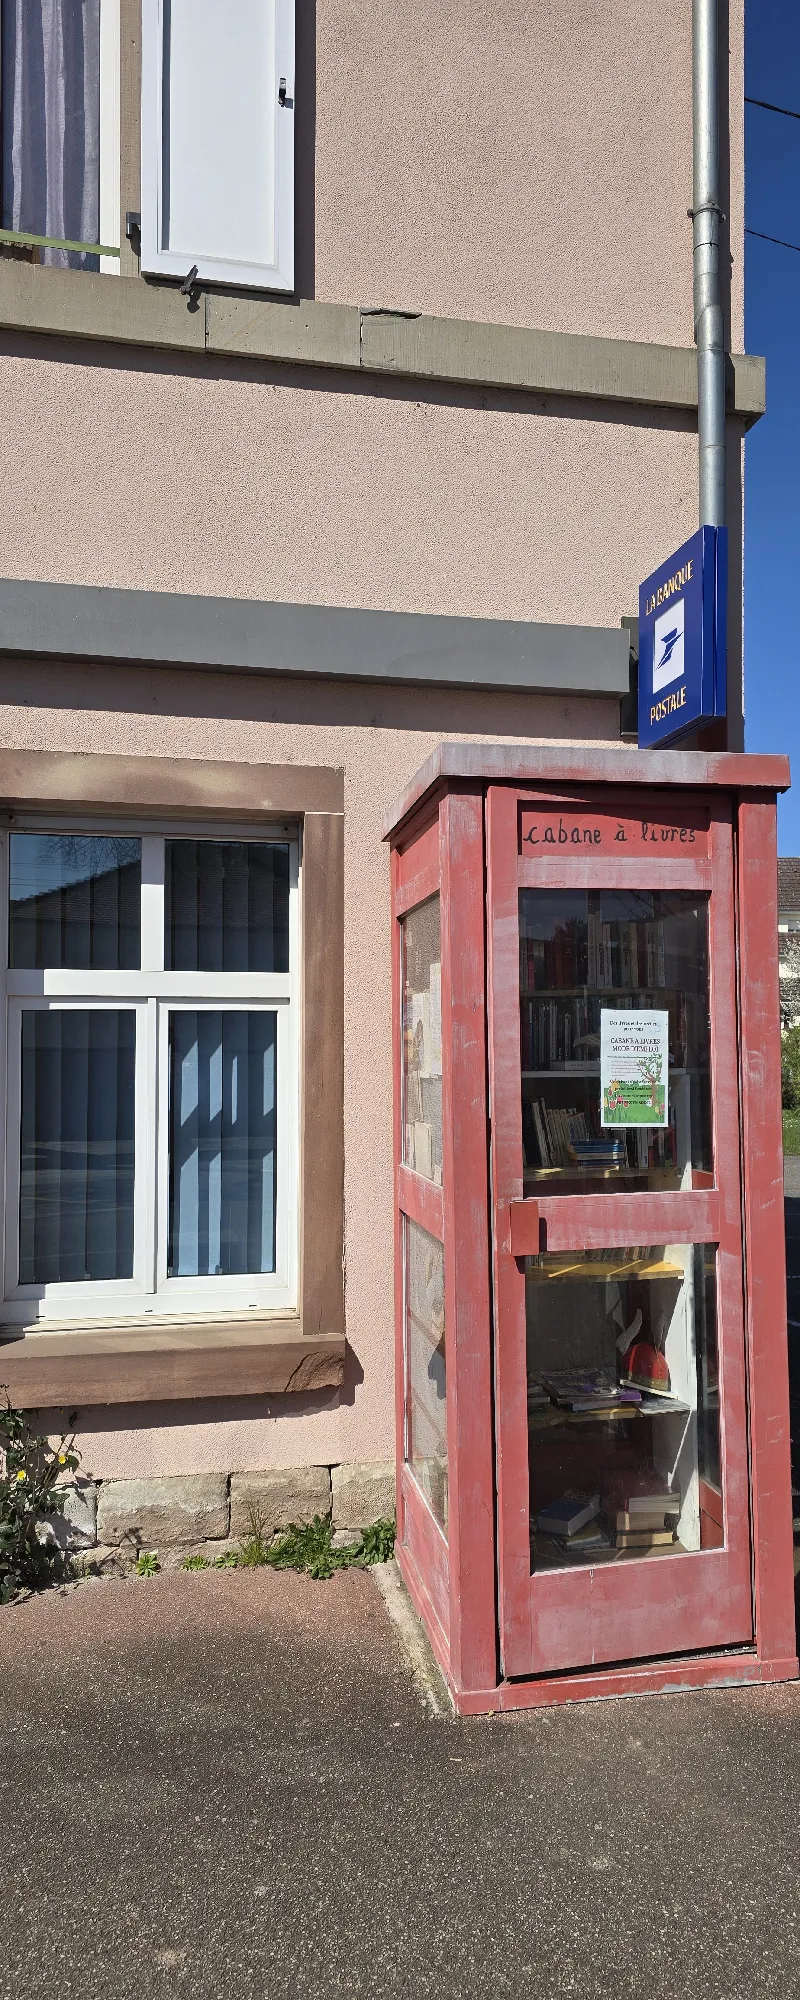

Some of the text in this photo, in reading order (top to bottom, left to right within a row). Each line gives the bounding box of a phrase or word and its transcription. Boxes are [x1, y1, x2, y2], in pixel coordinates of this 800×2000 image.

[646, 559, 694, 616] LA BANQUE
[650, 685, 687, 725] POSTALE
[523, 818, 696, 845] cabane à livres
